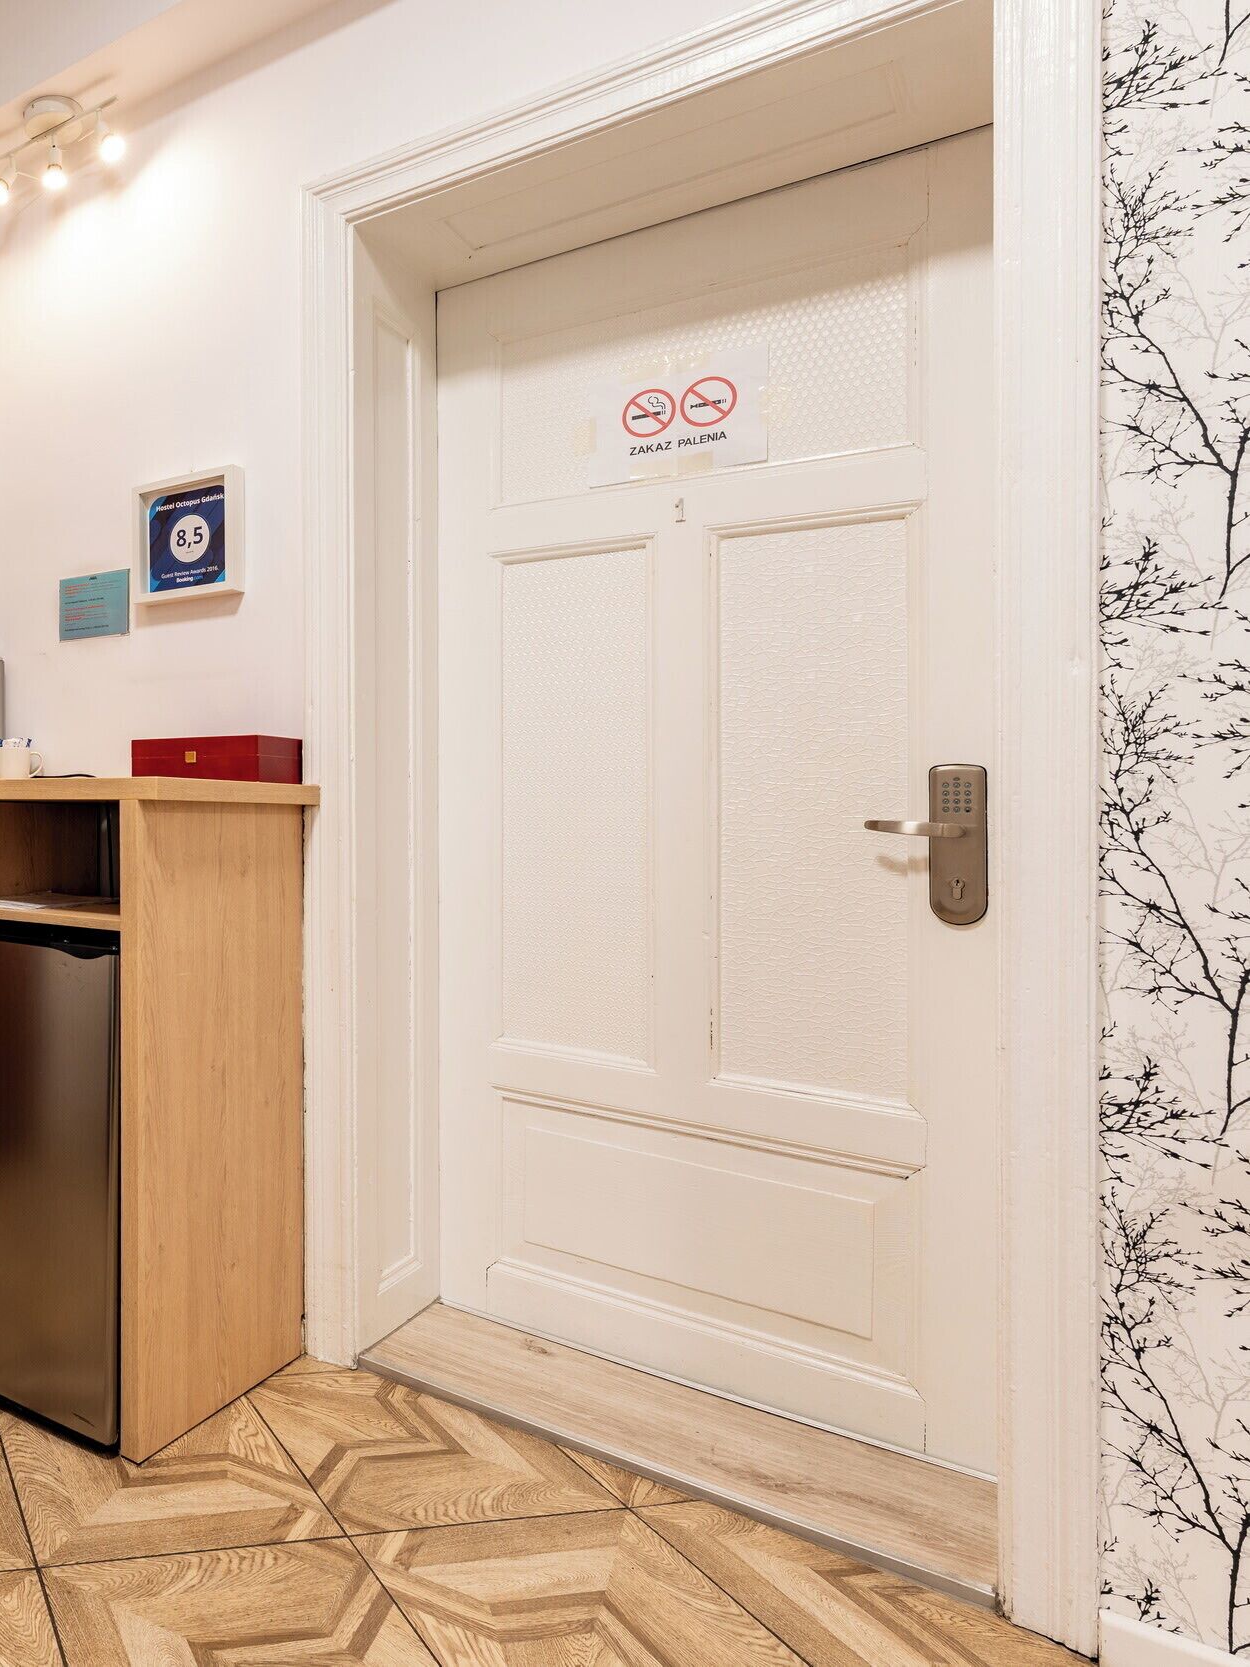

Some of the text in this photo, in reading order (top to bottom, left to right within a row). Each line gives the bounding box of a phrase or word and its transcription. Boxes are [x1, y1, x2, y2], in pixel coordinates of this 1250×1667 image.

[630, 431, 727, 456] ZAKAZ PALENIA
[156, 492, 225, 512] Hostel Octopus Gdańsk
[176, 526, 204, 549] 8,5
[190, 567, 207, 575] Awards
